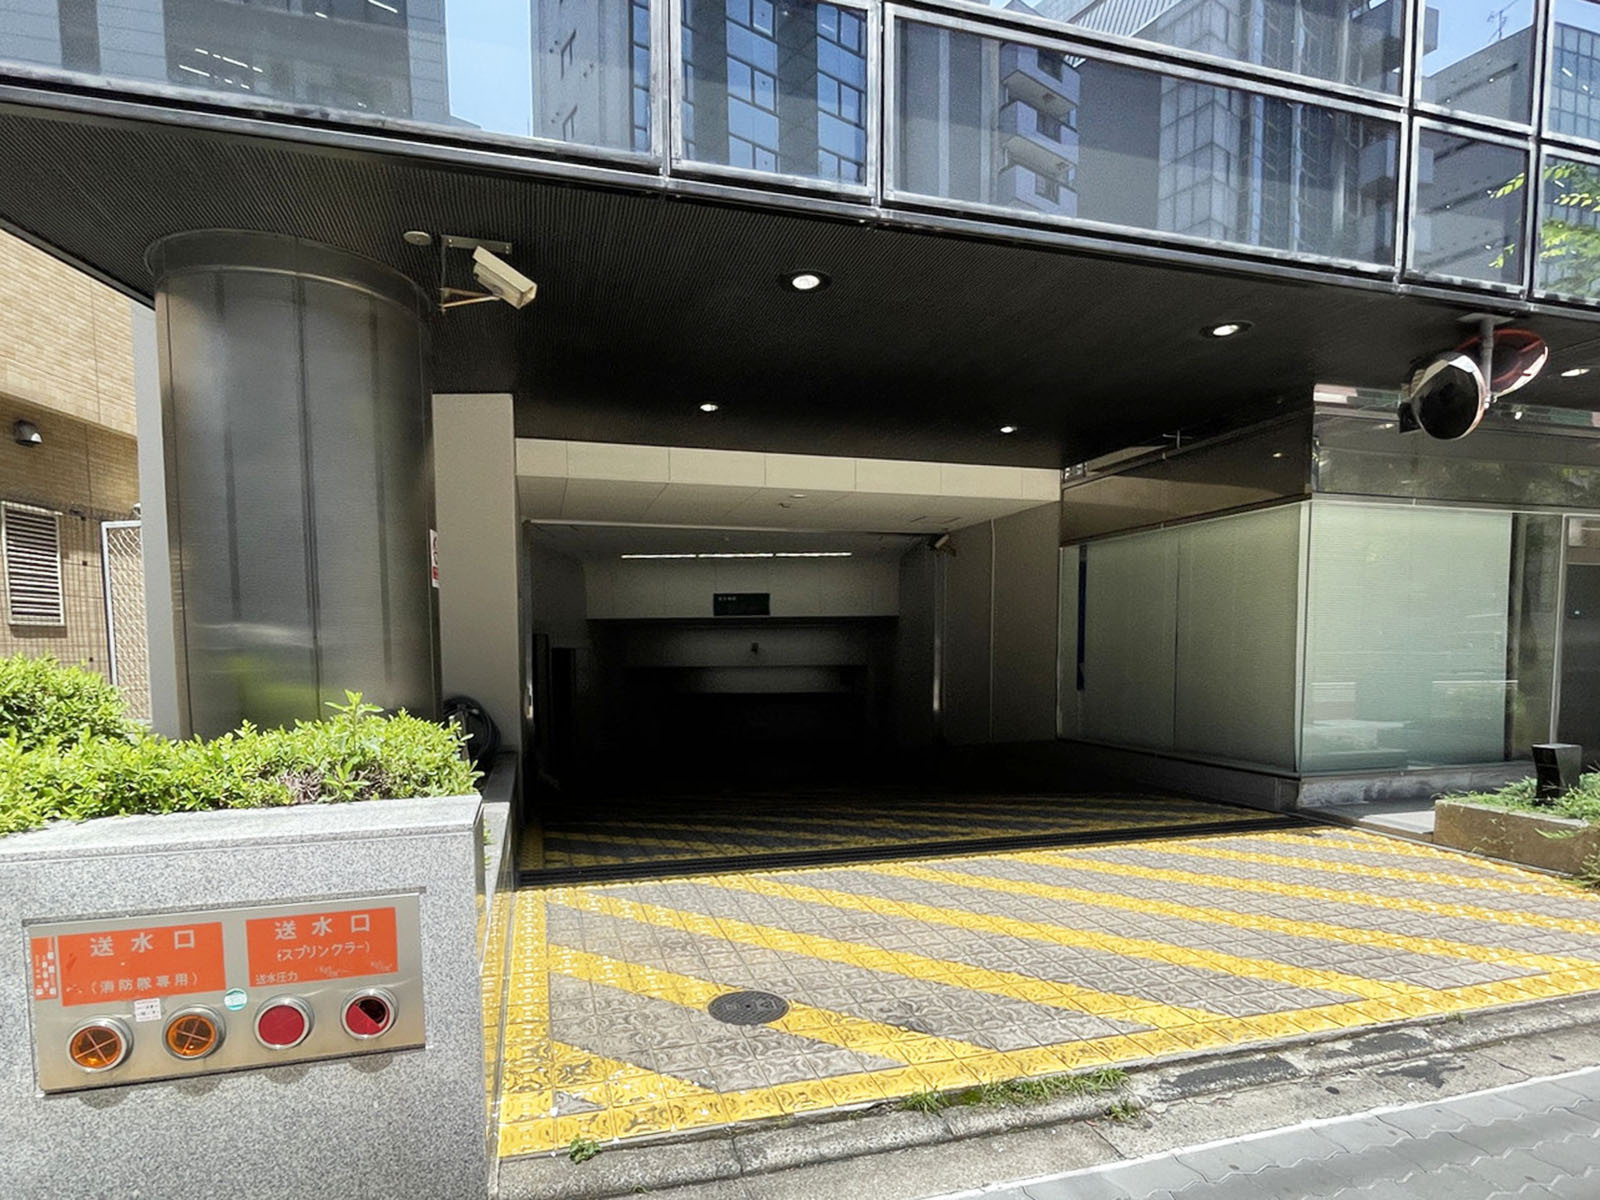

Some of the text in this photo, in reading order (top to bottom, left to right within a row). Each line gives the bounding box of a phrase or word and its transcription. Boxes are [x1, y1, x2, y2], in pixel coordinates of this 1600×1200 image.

[274, 914, 370, 941] 送水口
[90, 929, 196, 957] 送水口
